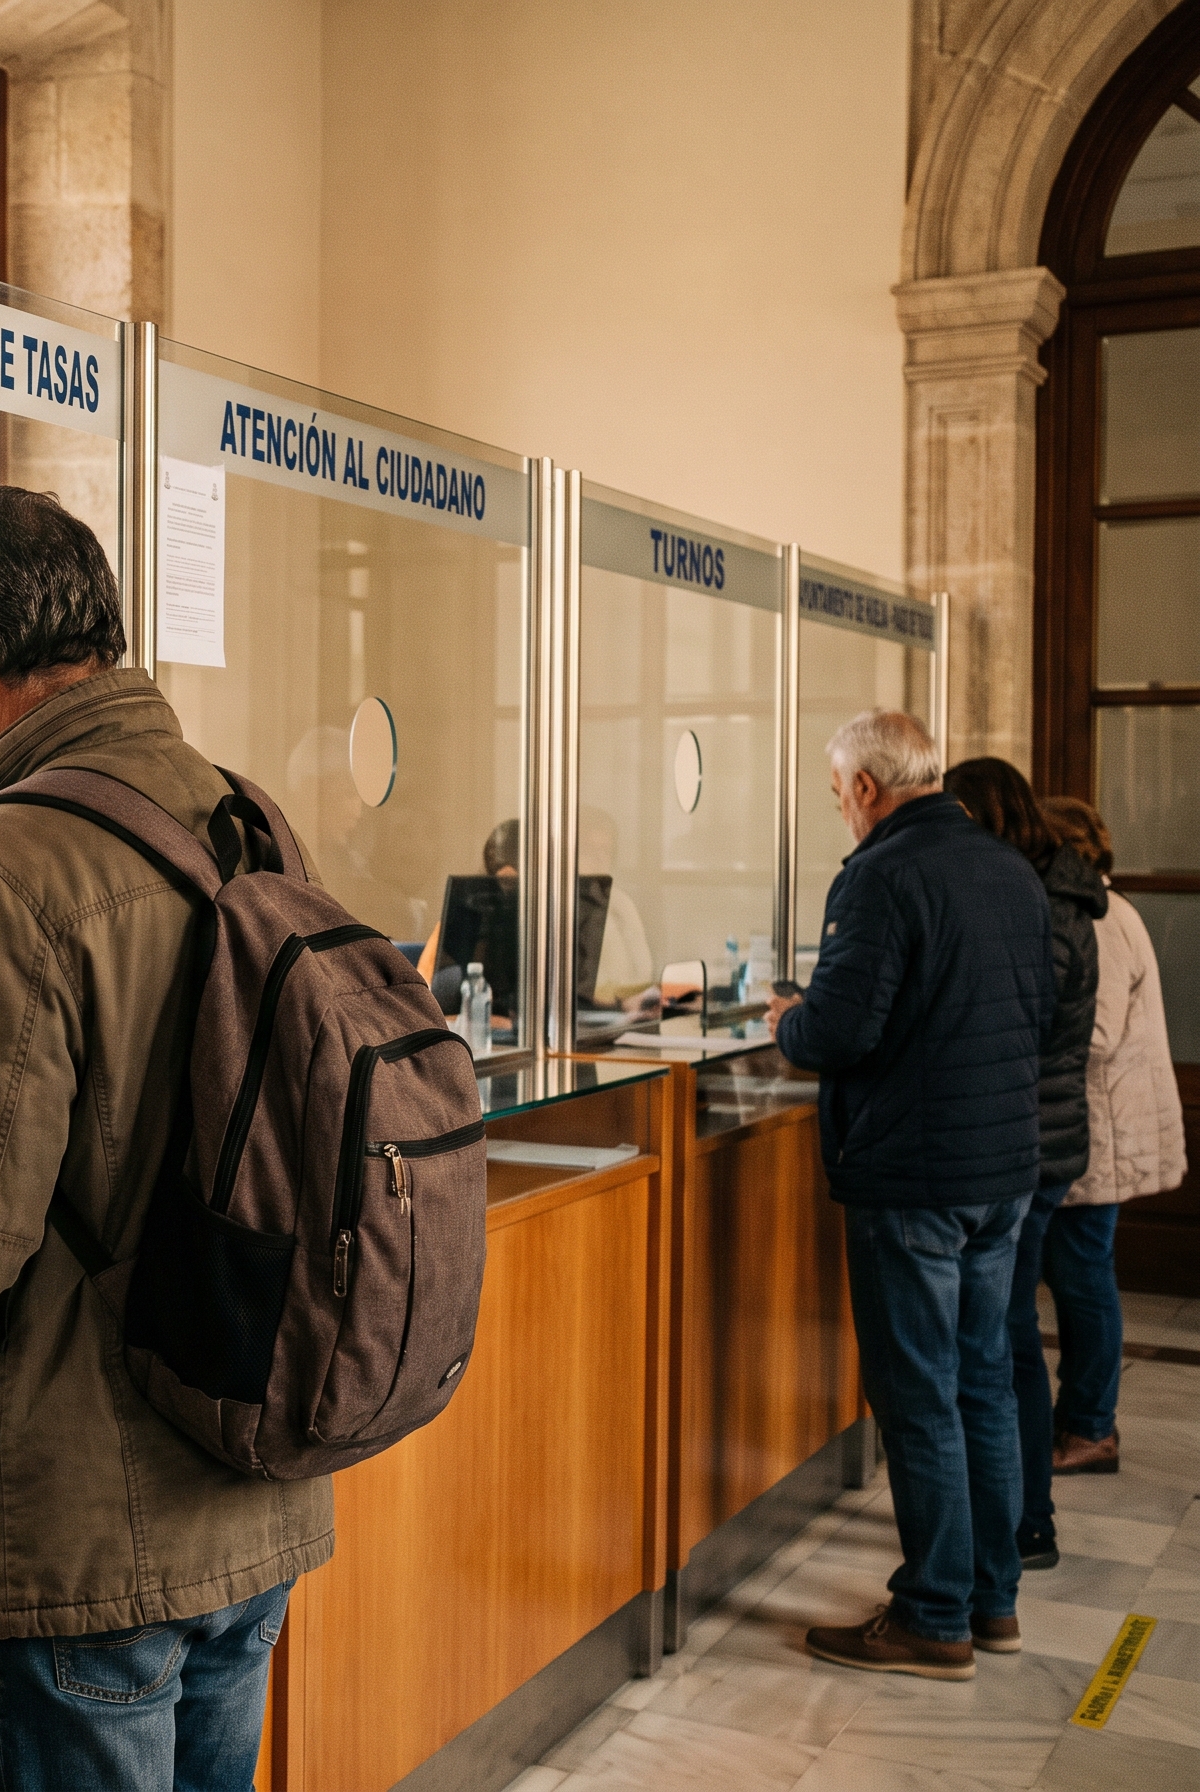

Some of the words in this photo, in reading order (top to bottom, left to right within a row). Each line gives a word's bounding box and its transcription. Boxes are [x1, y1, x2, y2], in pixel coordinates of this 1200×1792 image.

[22, 334, 100, 413] TASAS
[220, 400, 336, 482] ATENCIÓN
[342, 436, 370, 491] AL
[376, 445, 486, 521] CIUDADANO
[650, 528, 725, 590] TURNOS
